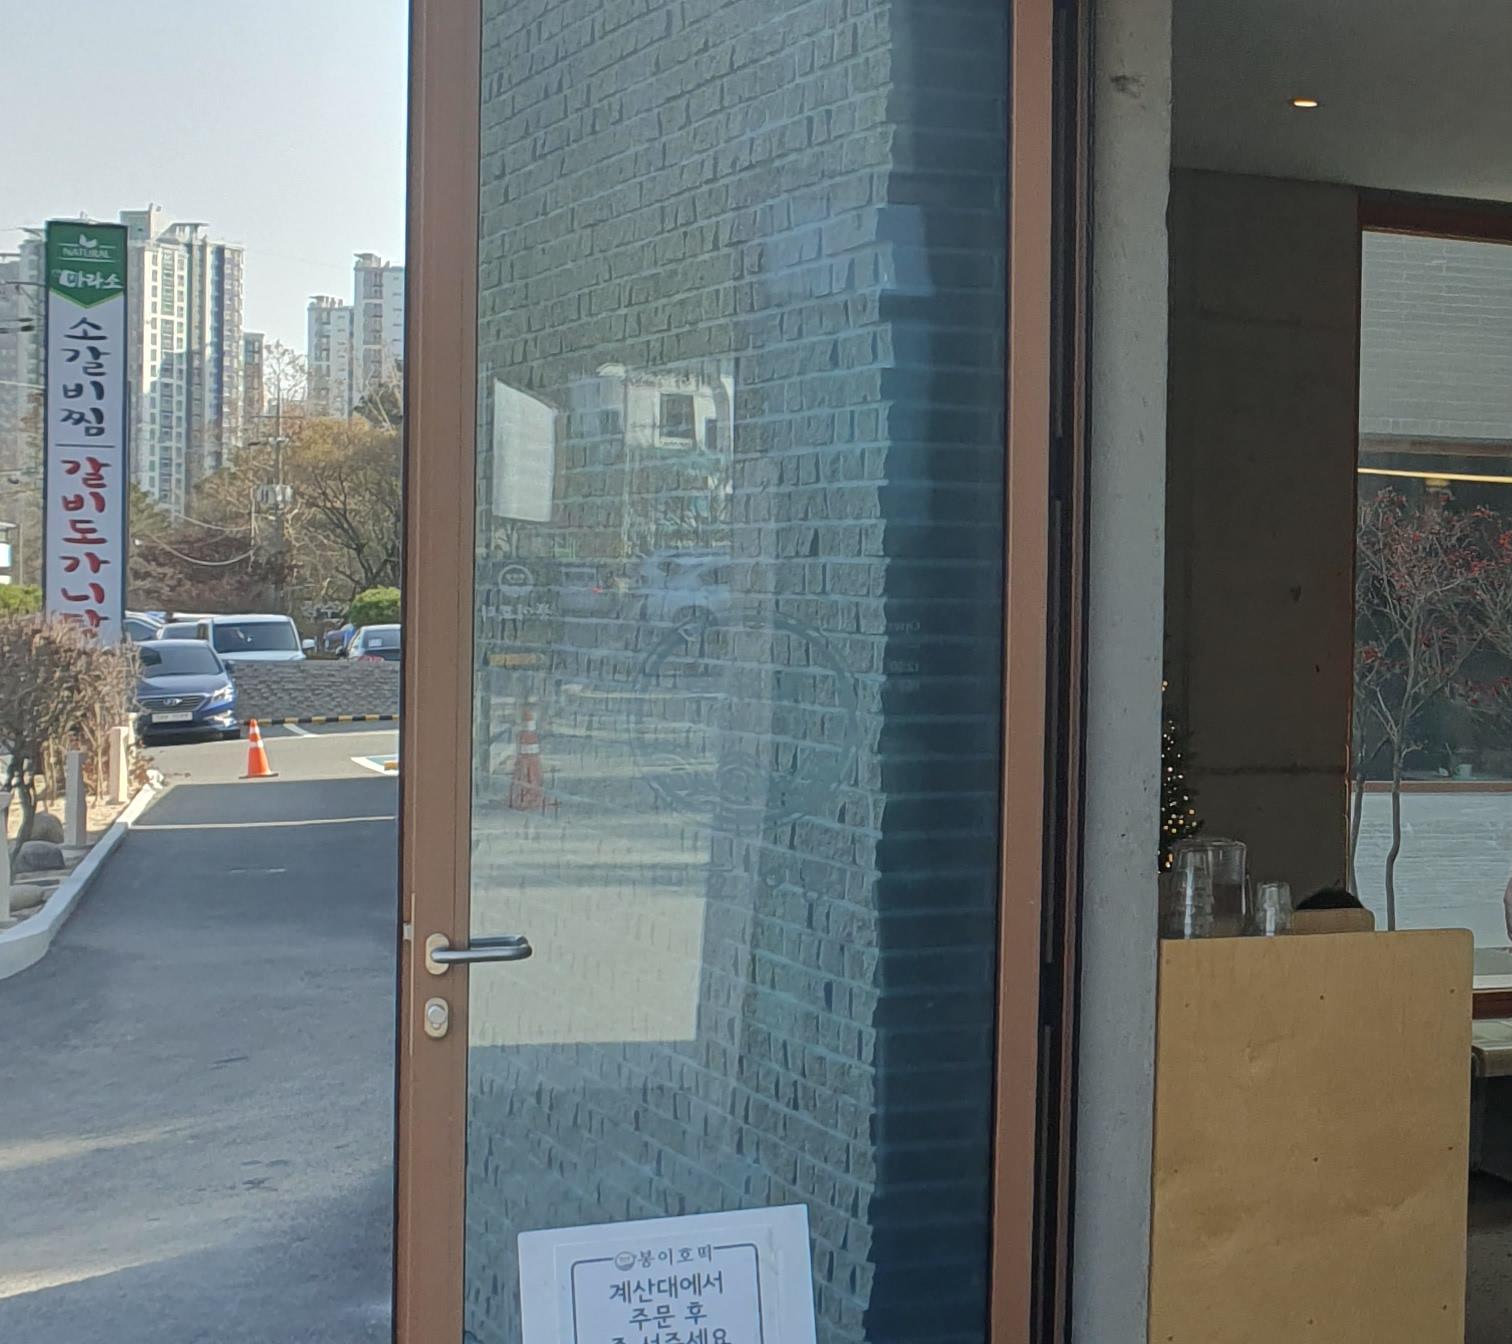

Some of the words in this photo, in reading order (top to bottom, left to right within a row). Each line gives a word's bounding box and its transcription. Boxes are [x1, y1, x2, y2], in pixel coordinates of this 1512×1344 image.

[60, 317, 112, 437] 소갈비찜
[609, 1270, 723, 1304] 계산대에서
[629, 1304, 676, 1332] 주문
[684, 1301, 708, 1326] 후
